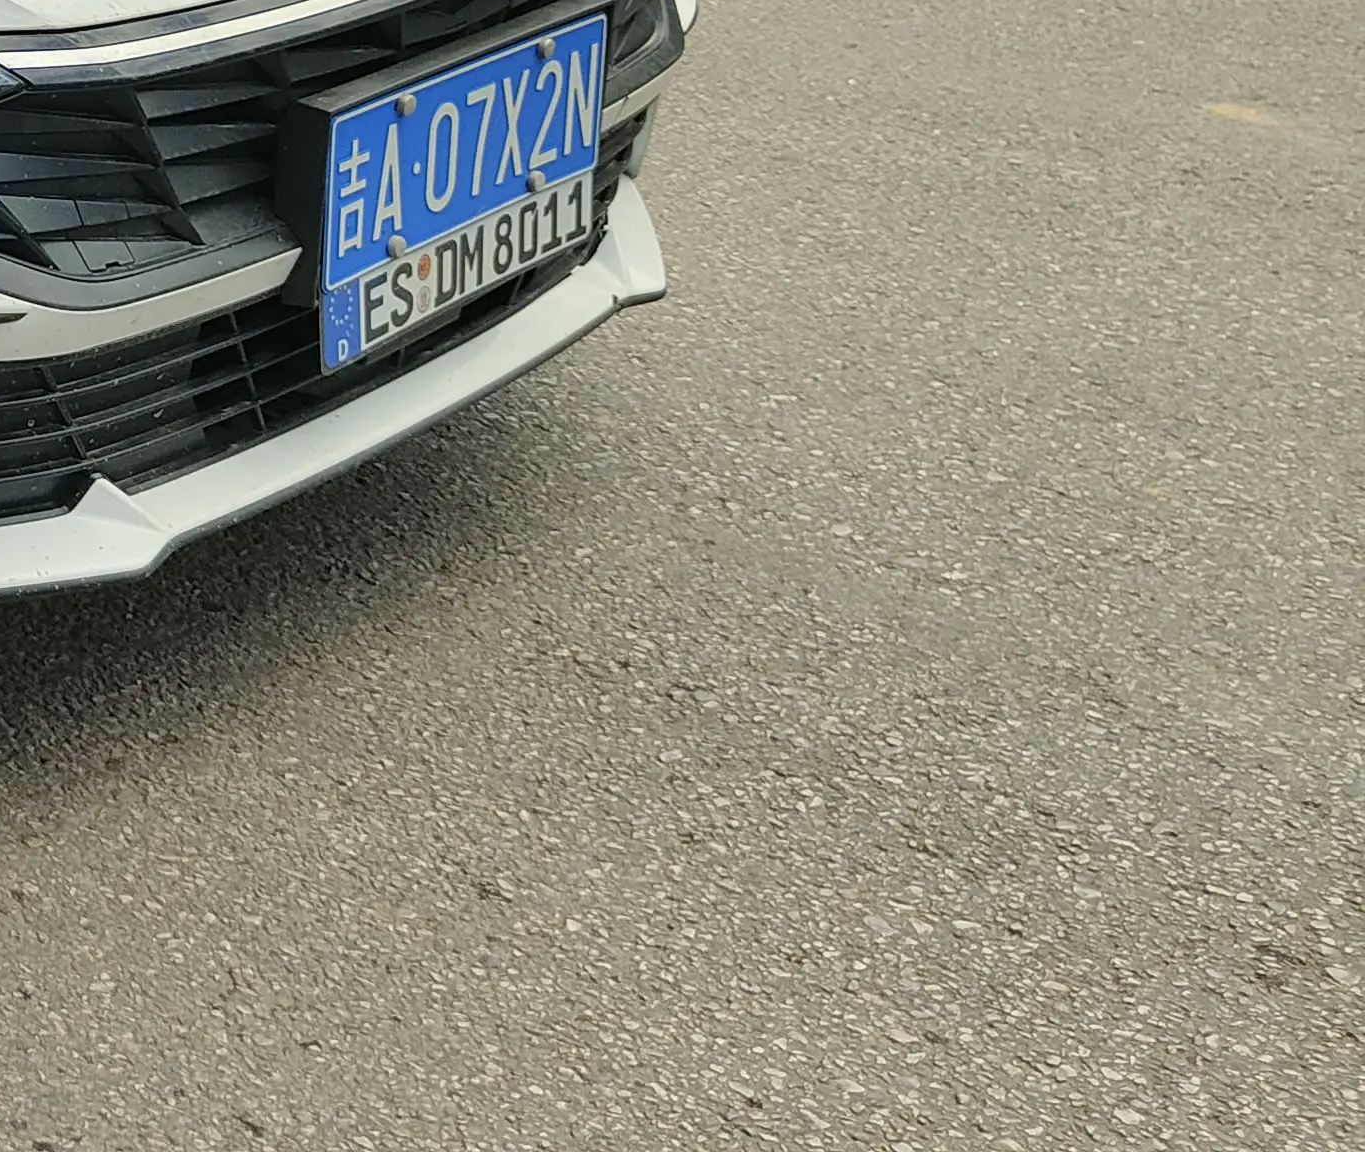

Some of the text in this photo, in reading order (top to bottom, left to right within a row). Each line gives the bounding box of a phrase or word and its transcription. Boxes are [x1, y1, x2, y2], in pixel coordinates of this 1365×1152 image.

[365, 180, 587, 344] ES DM 8011
[338, 338, 349, 362] D
